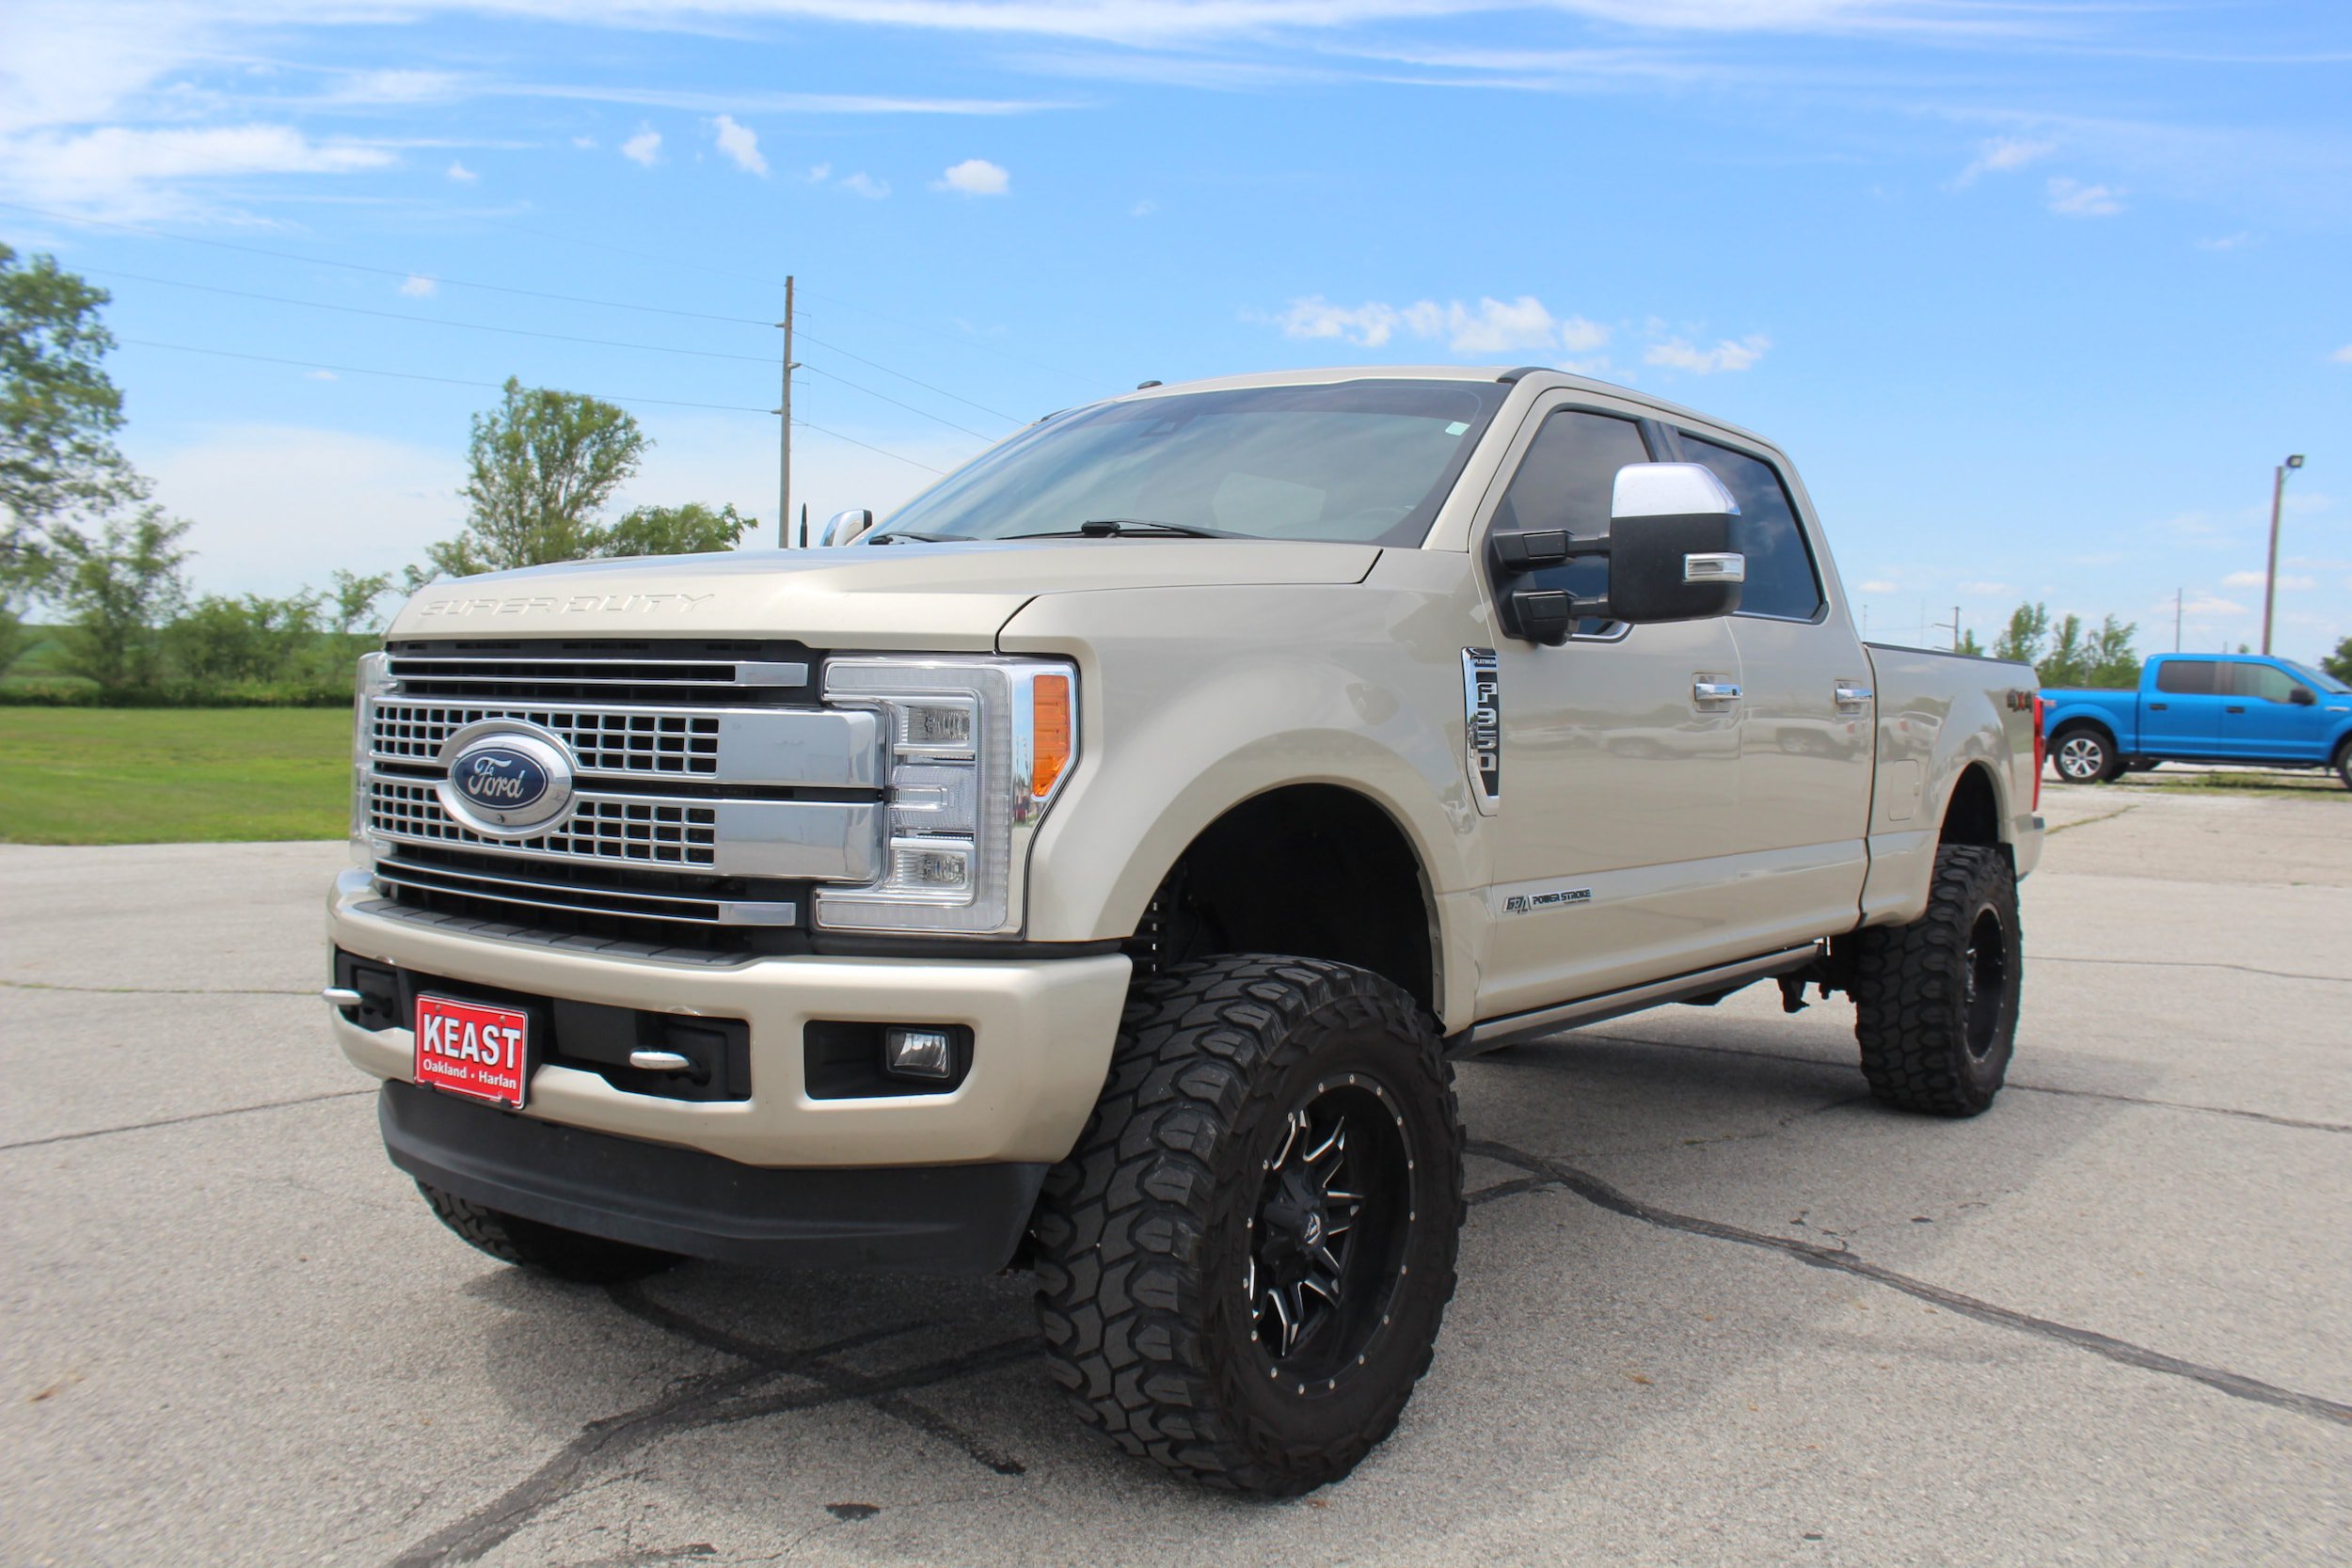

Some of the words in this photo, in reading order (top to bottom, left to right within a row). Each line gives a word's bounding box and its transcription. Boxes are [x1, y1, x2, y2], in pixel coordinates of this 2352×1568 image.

[418, 596, 558, 617] SUPER
[560, 593, 716, 614] DUTY
[468, 756, 527, 799] Ford
[1533, 893, 1560, 905] POWER
[1561, 889, 1591, 901] STROKE
[422, 1013, 522, 1069] KEAST
[422, 1058, 468, 1080] Oakland
[478, 1069, 517, 1090] Harlan
